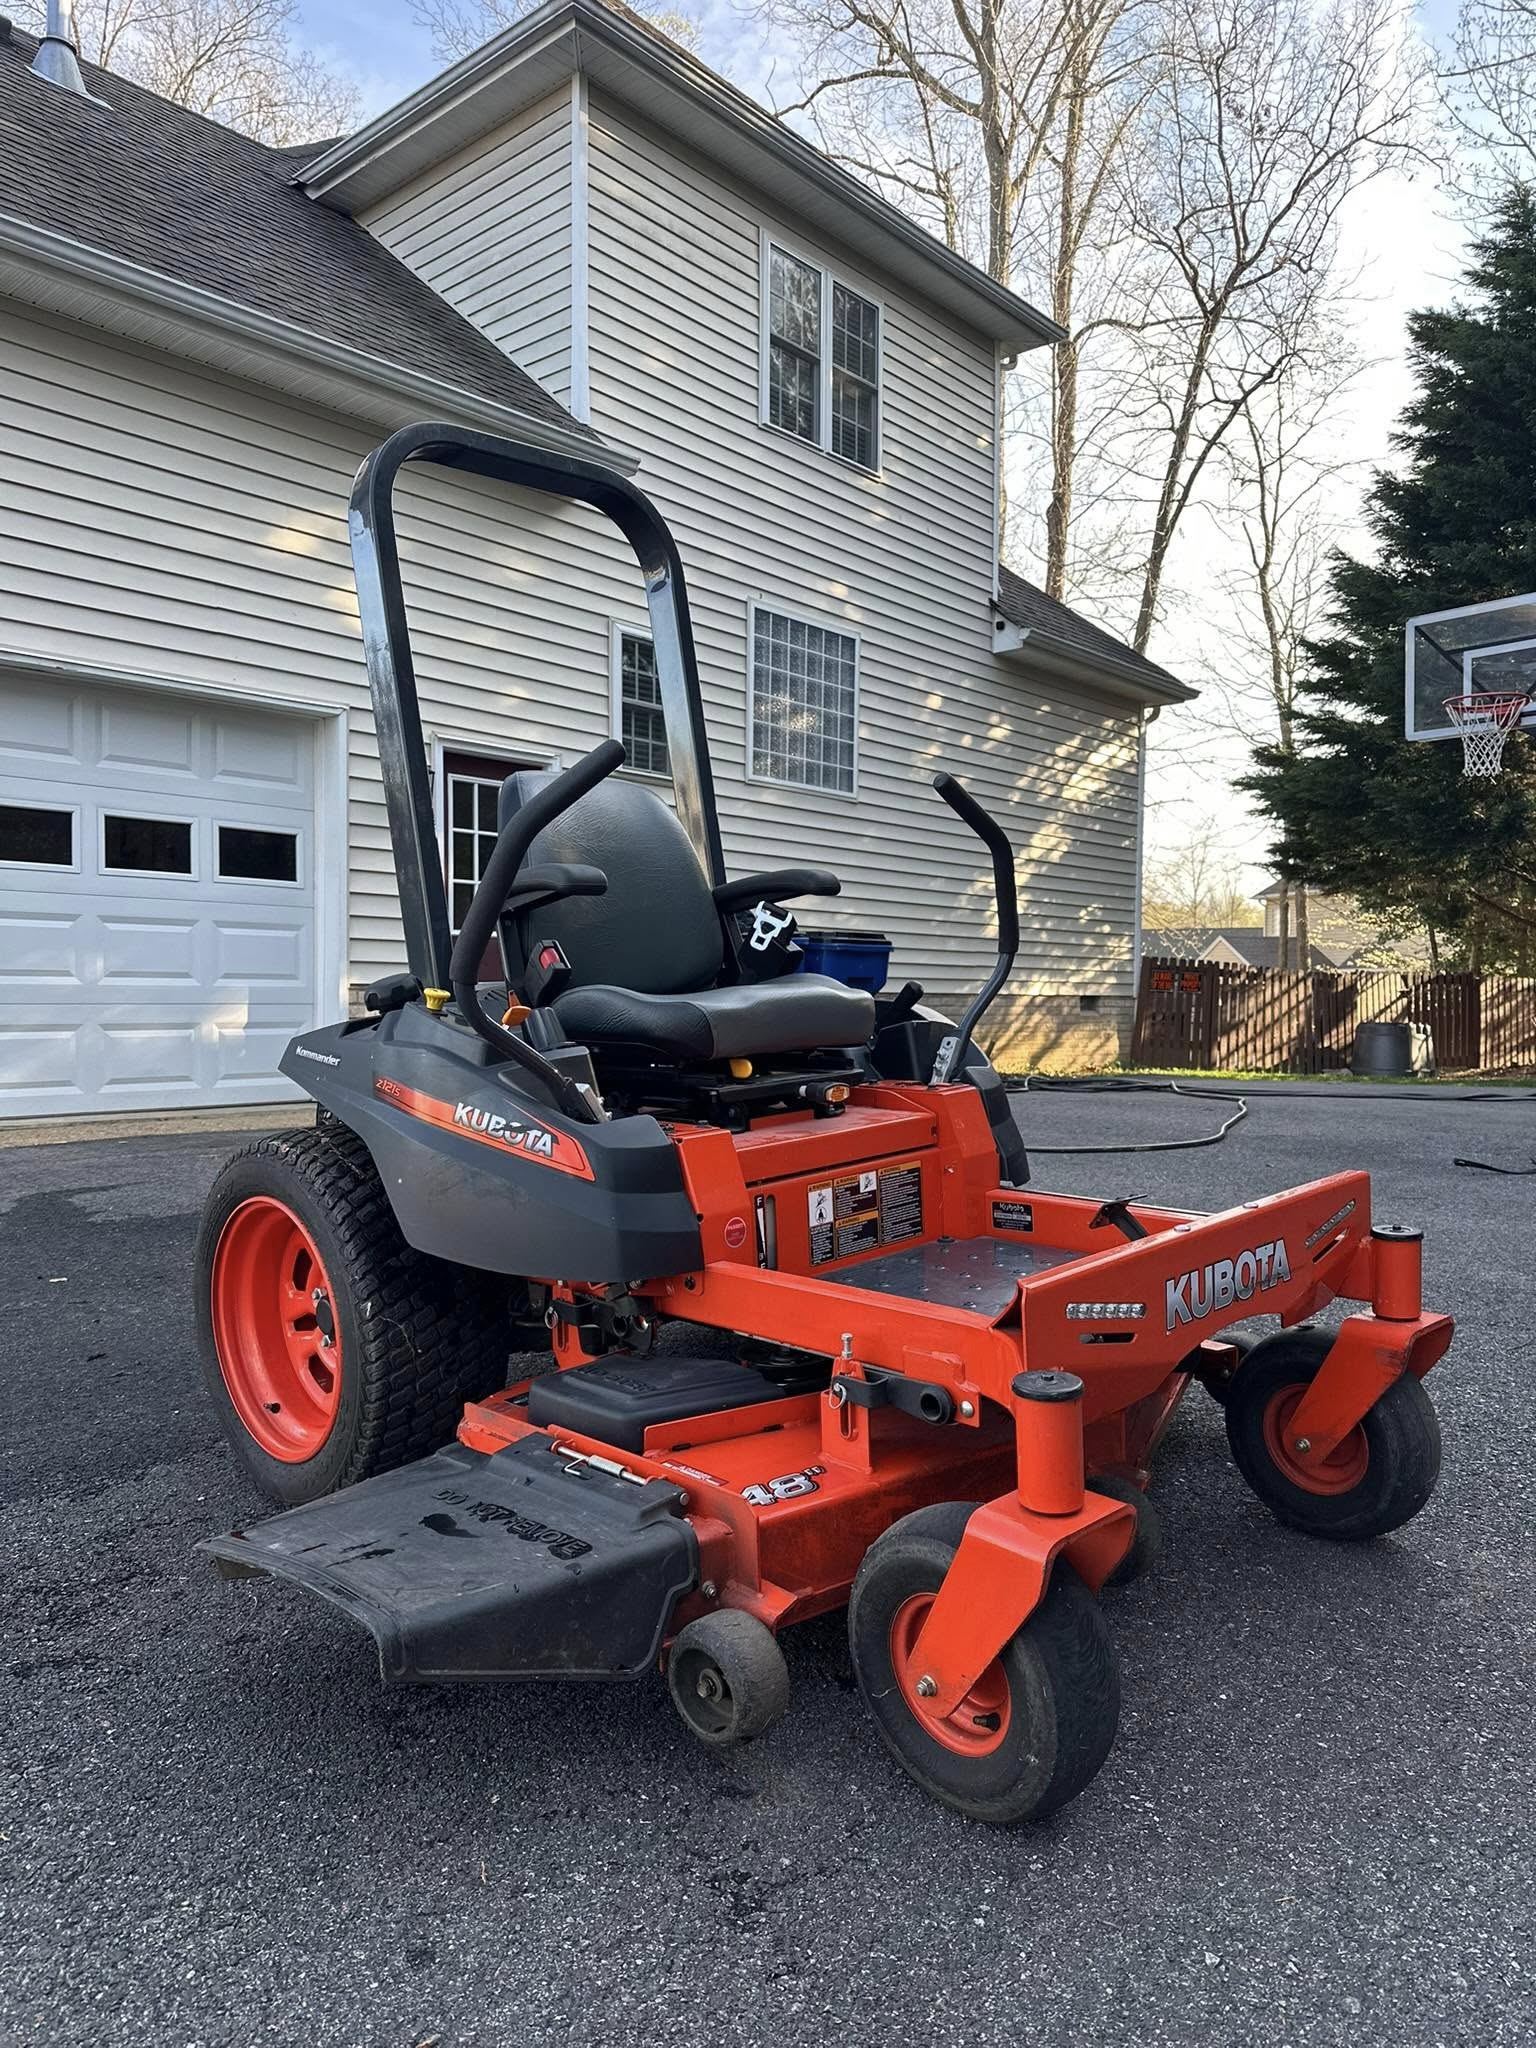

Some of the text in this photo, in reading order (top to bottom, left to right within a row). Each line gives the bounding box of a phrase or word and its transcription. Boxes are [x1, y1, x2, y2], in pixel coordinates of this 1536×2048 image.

[295, 1045, 342, 1067] Kommander
[453, 1102, 554, 1156] KUBOTA
[1165, 1238, 1291, 1331] KUBOTA
[432, 1488, 469, 1505] DO
[504, 1516, 592, 1560] REMOVE
